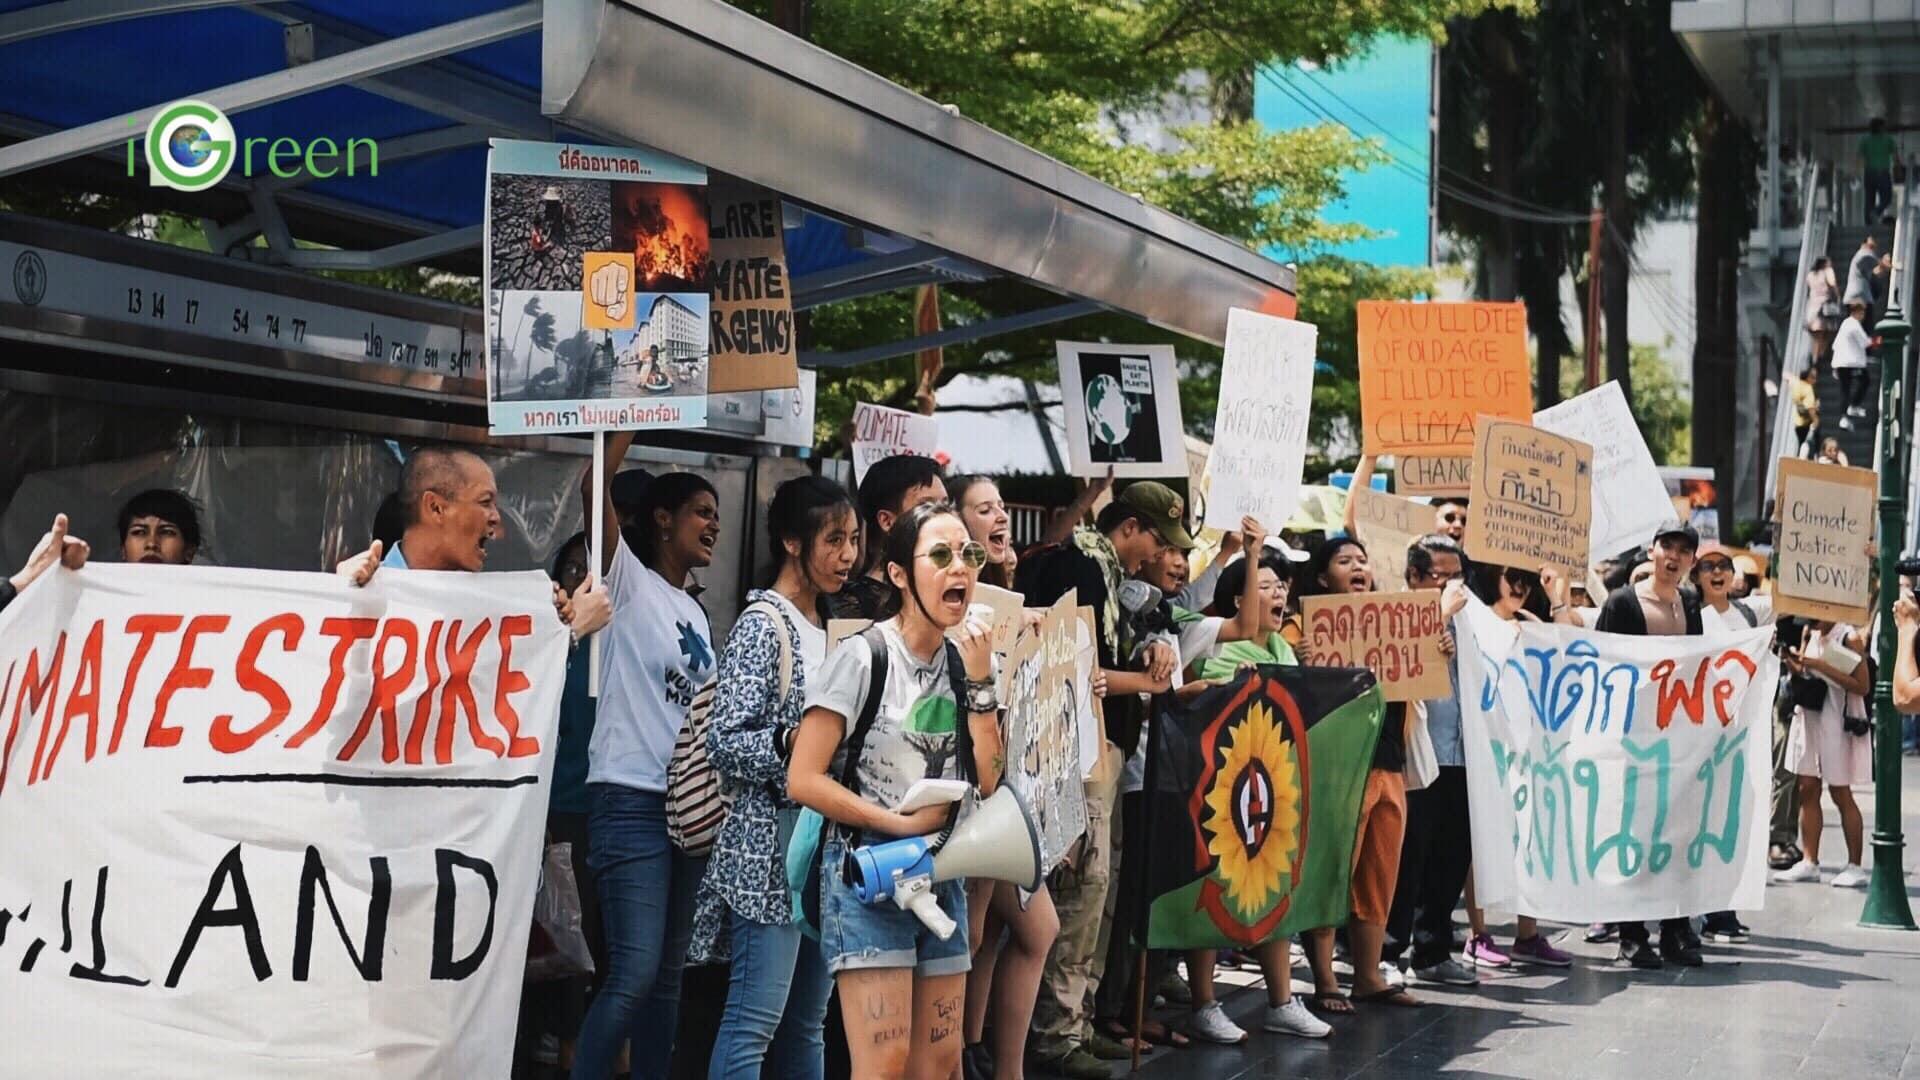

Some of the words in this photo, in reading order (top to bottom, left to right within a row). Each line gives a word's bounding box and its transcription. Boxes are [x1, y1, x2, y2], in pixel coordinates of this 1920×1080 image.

[128, 287, 142, 314] 13
[152, 292, 165, 319] 14
[185, 299, 199, 325] 17
[233, 308, 249, 334] 54
[266, 314, 280, 339] 74
[292, 318, 307, 343] 77
[708, 308, 793, 355] RGENCY
[1472, 307, 1521, 335] DIE
[1375, 410, 1508, 444] CLIMA
[1791, 499, 1858, 536] Climate
[1786, 530, 1847, 557] Justice
[207, 612, 541, 766] STRIKE
